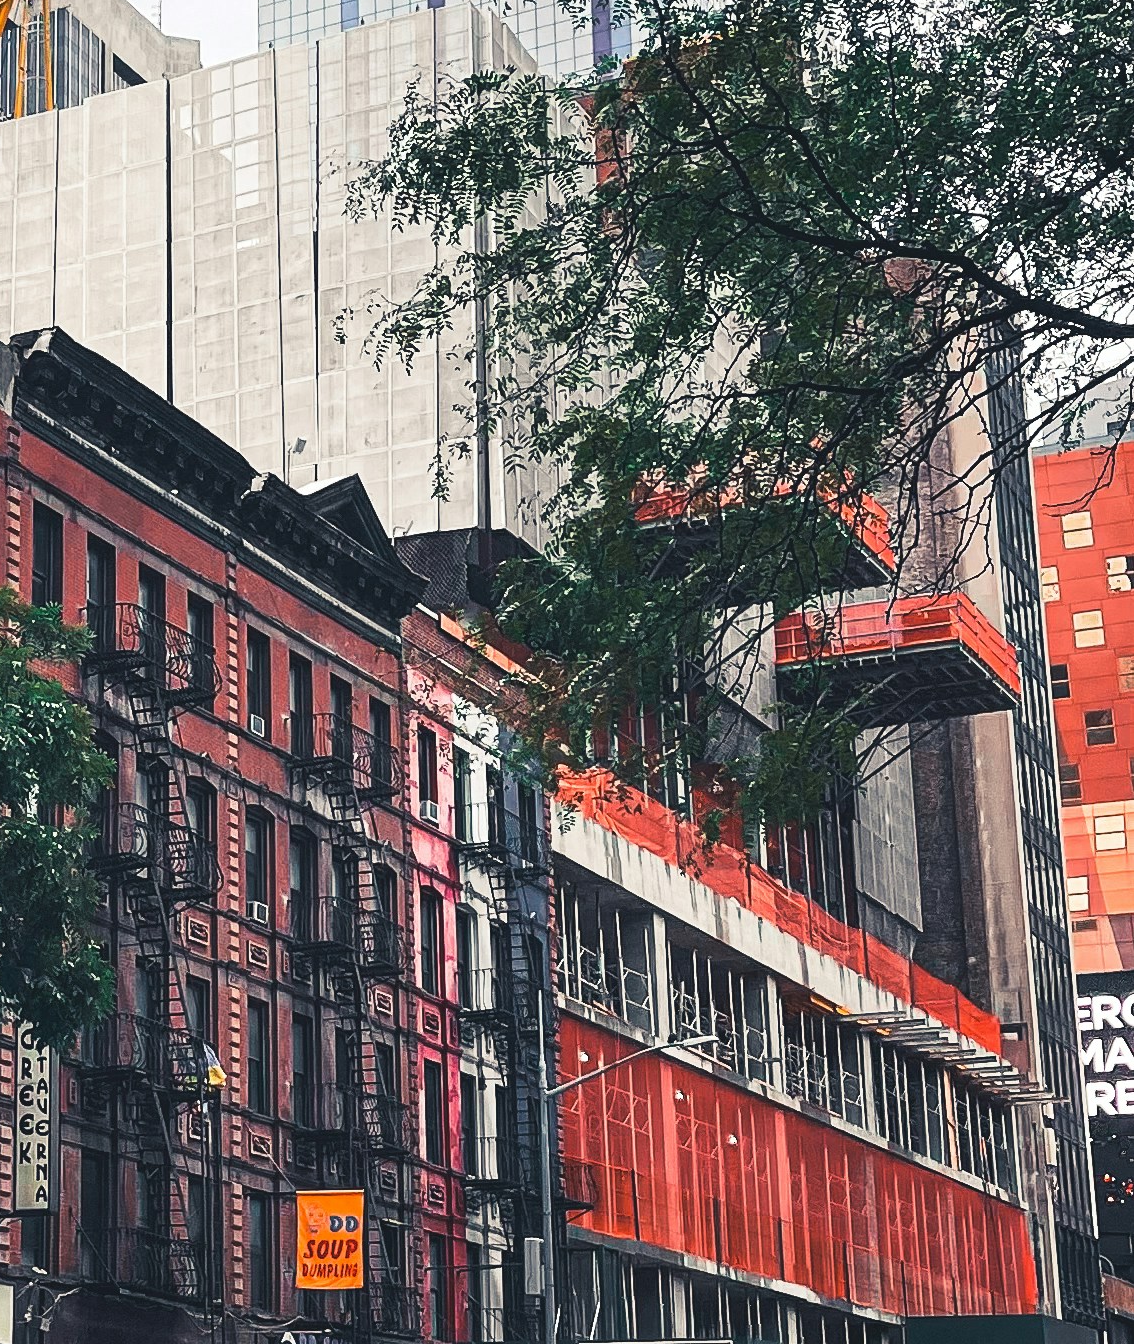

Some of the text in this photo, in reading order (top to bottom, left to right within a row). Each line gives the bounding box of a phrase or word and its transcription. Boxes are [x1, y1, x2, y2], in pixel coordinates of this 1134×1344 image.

[18, 1027, 35, 1165] GREEK
[35, 1056, 50, 1203] TAVERNA
[302, 1262, 359, 1279] DUMPLING
[303, 1239, 359, 1260] SOUP
